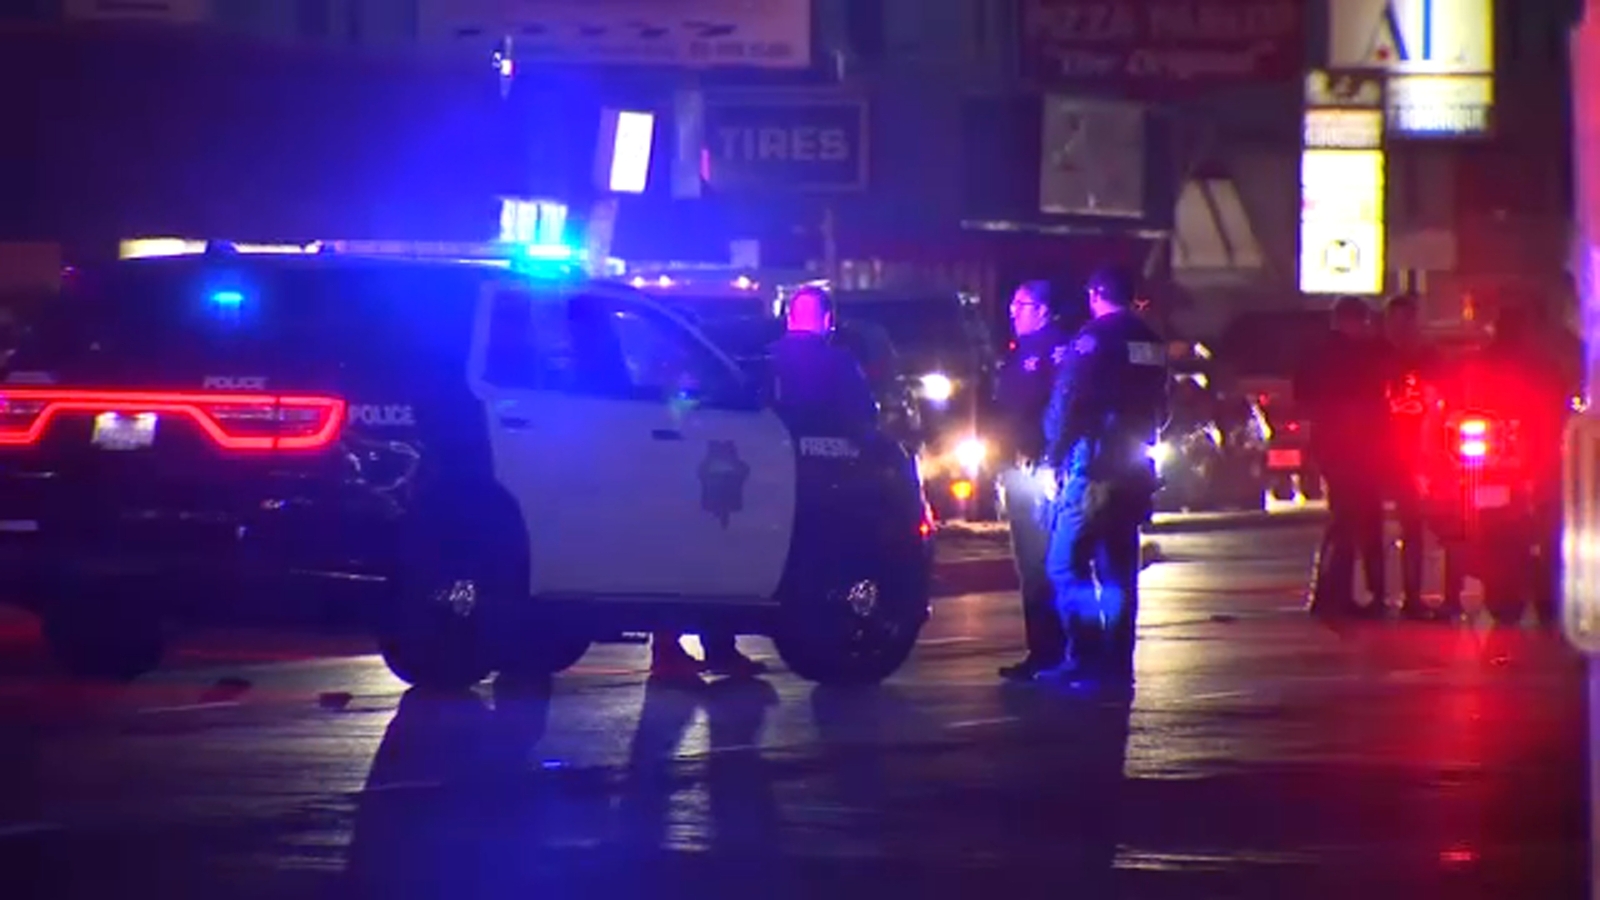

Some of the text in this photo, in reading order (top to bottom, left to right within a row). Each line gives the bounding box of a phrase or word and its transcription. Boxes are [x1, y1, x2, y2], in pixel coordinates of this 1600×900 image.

[718, 126, 850, 161] TIRES
[203, 375, 268, 390] POLICE
[349, 404, 416, 425] POLICE
